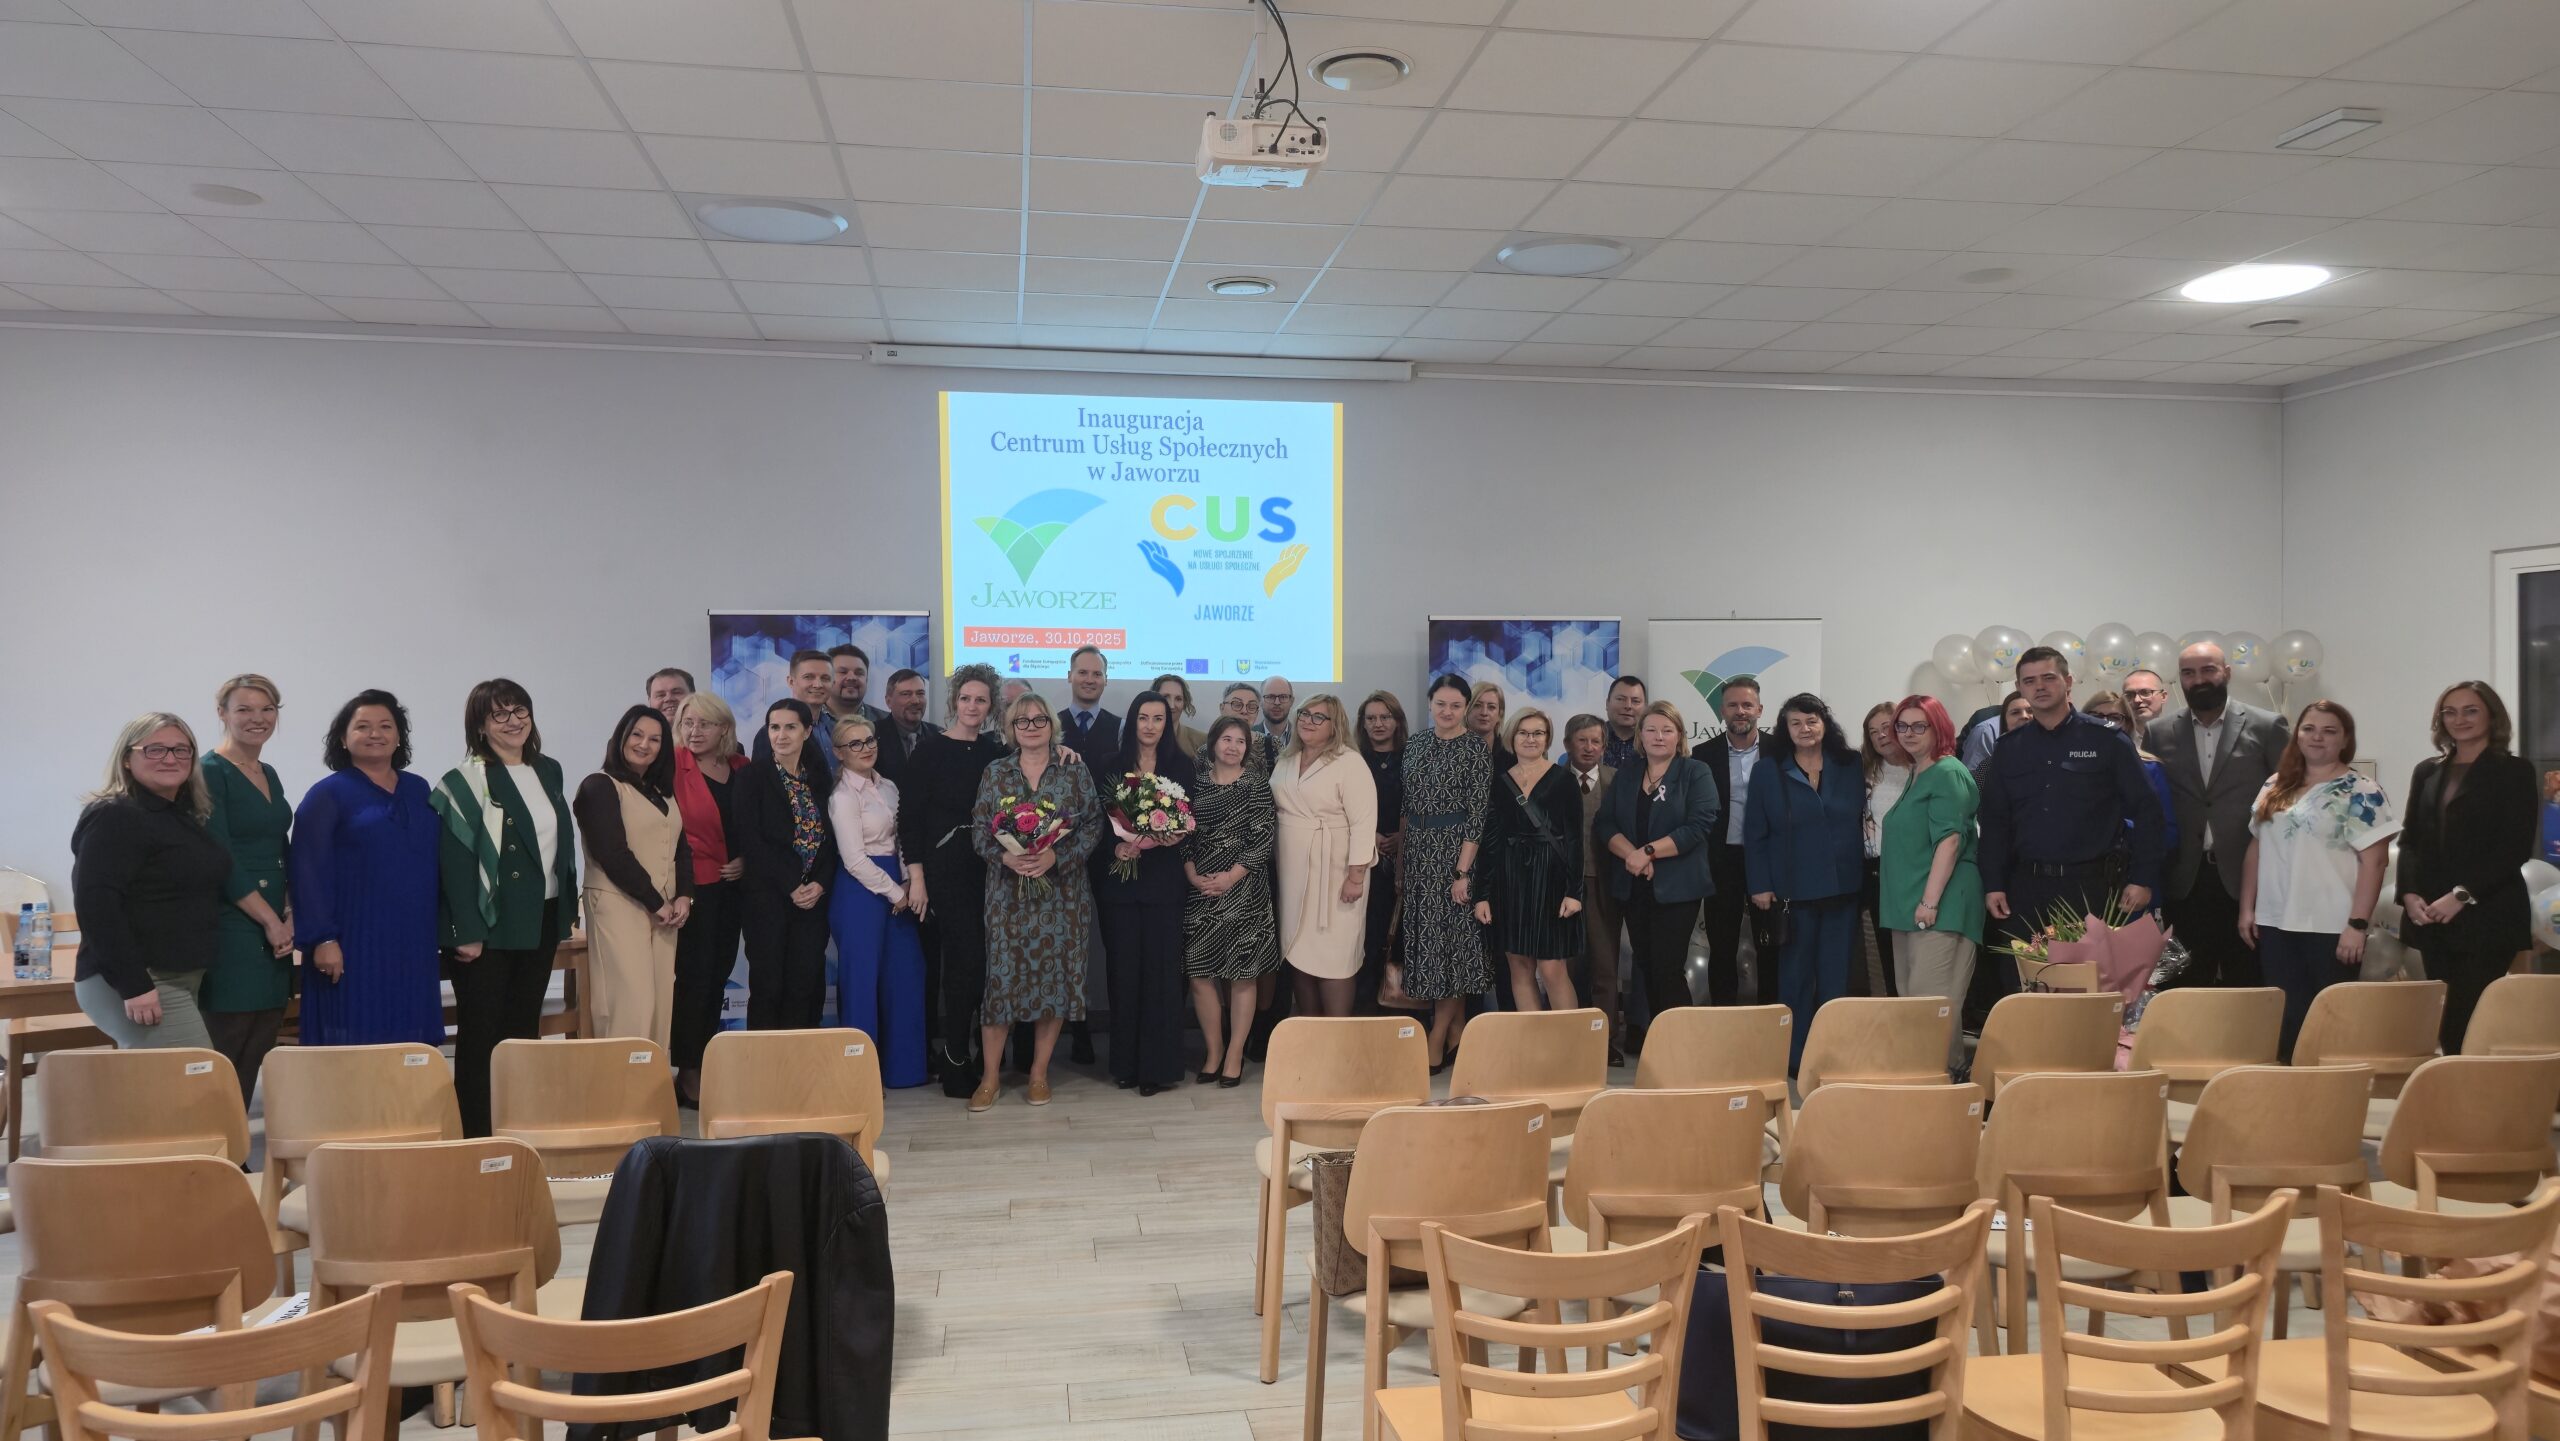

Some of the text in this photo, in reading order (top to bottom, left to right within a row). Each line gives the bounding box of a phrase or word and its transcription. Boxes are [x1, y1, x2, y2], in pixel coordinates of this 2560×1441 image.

[1077, 407, 1204, 435] Inauguracja
[990, 431, 1288, 463] Centrum Usług Społecznych
[1087, 461, 1200, 483] w Jaworzu
[1150, 494, 1296, 543] CUS
[1193, 549, 1253, 560] NOWE SPOJRZENIE
[1187, 561, 1197, 570] NA
[1194, 604, 1255, 621] JAWORZE
[1045, 631, 1121, 646] 30.10.2025
[2069, 750, 2097, 758] POLICJA
